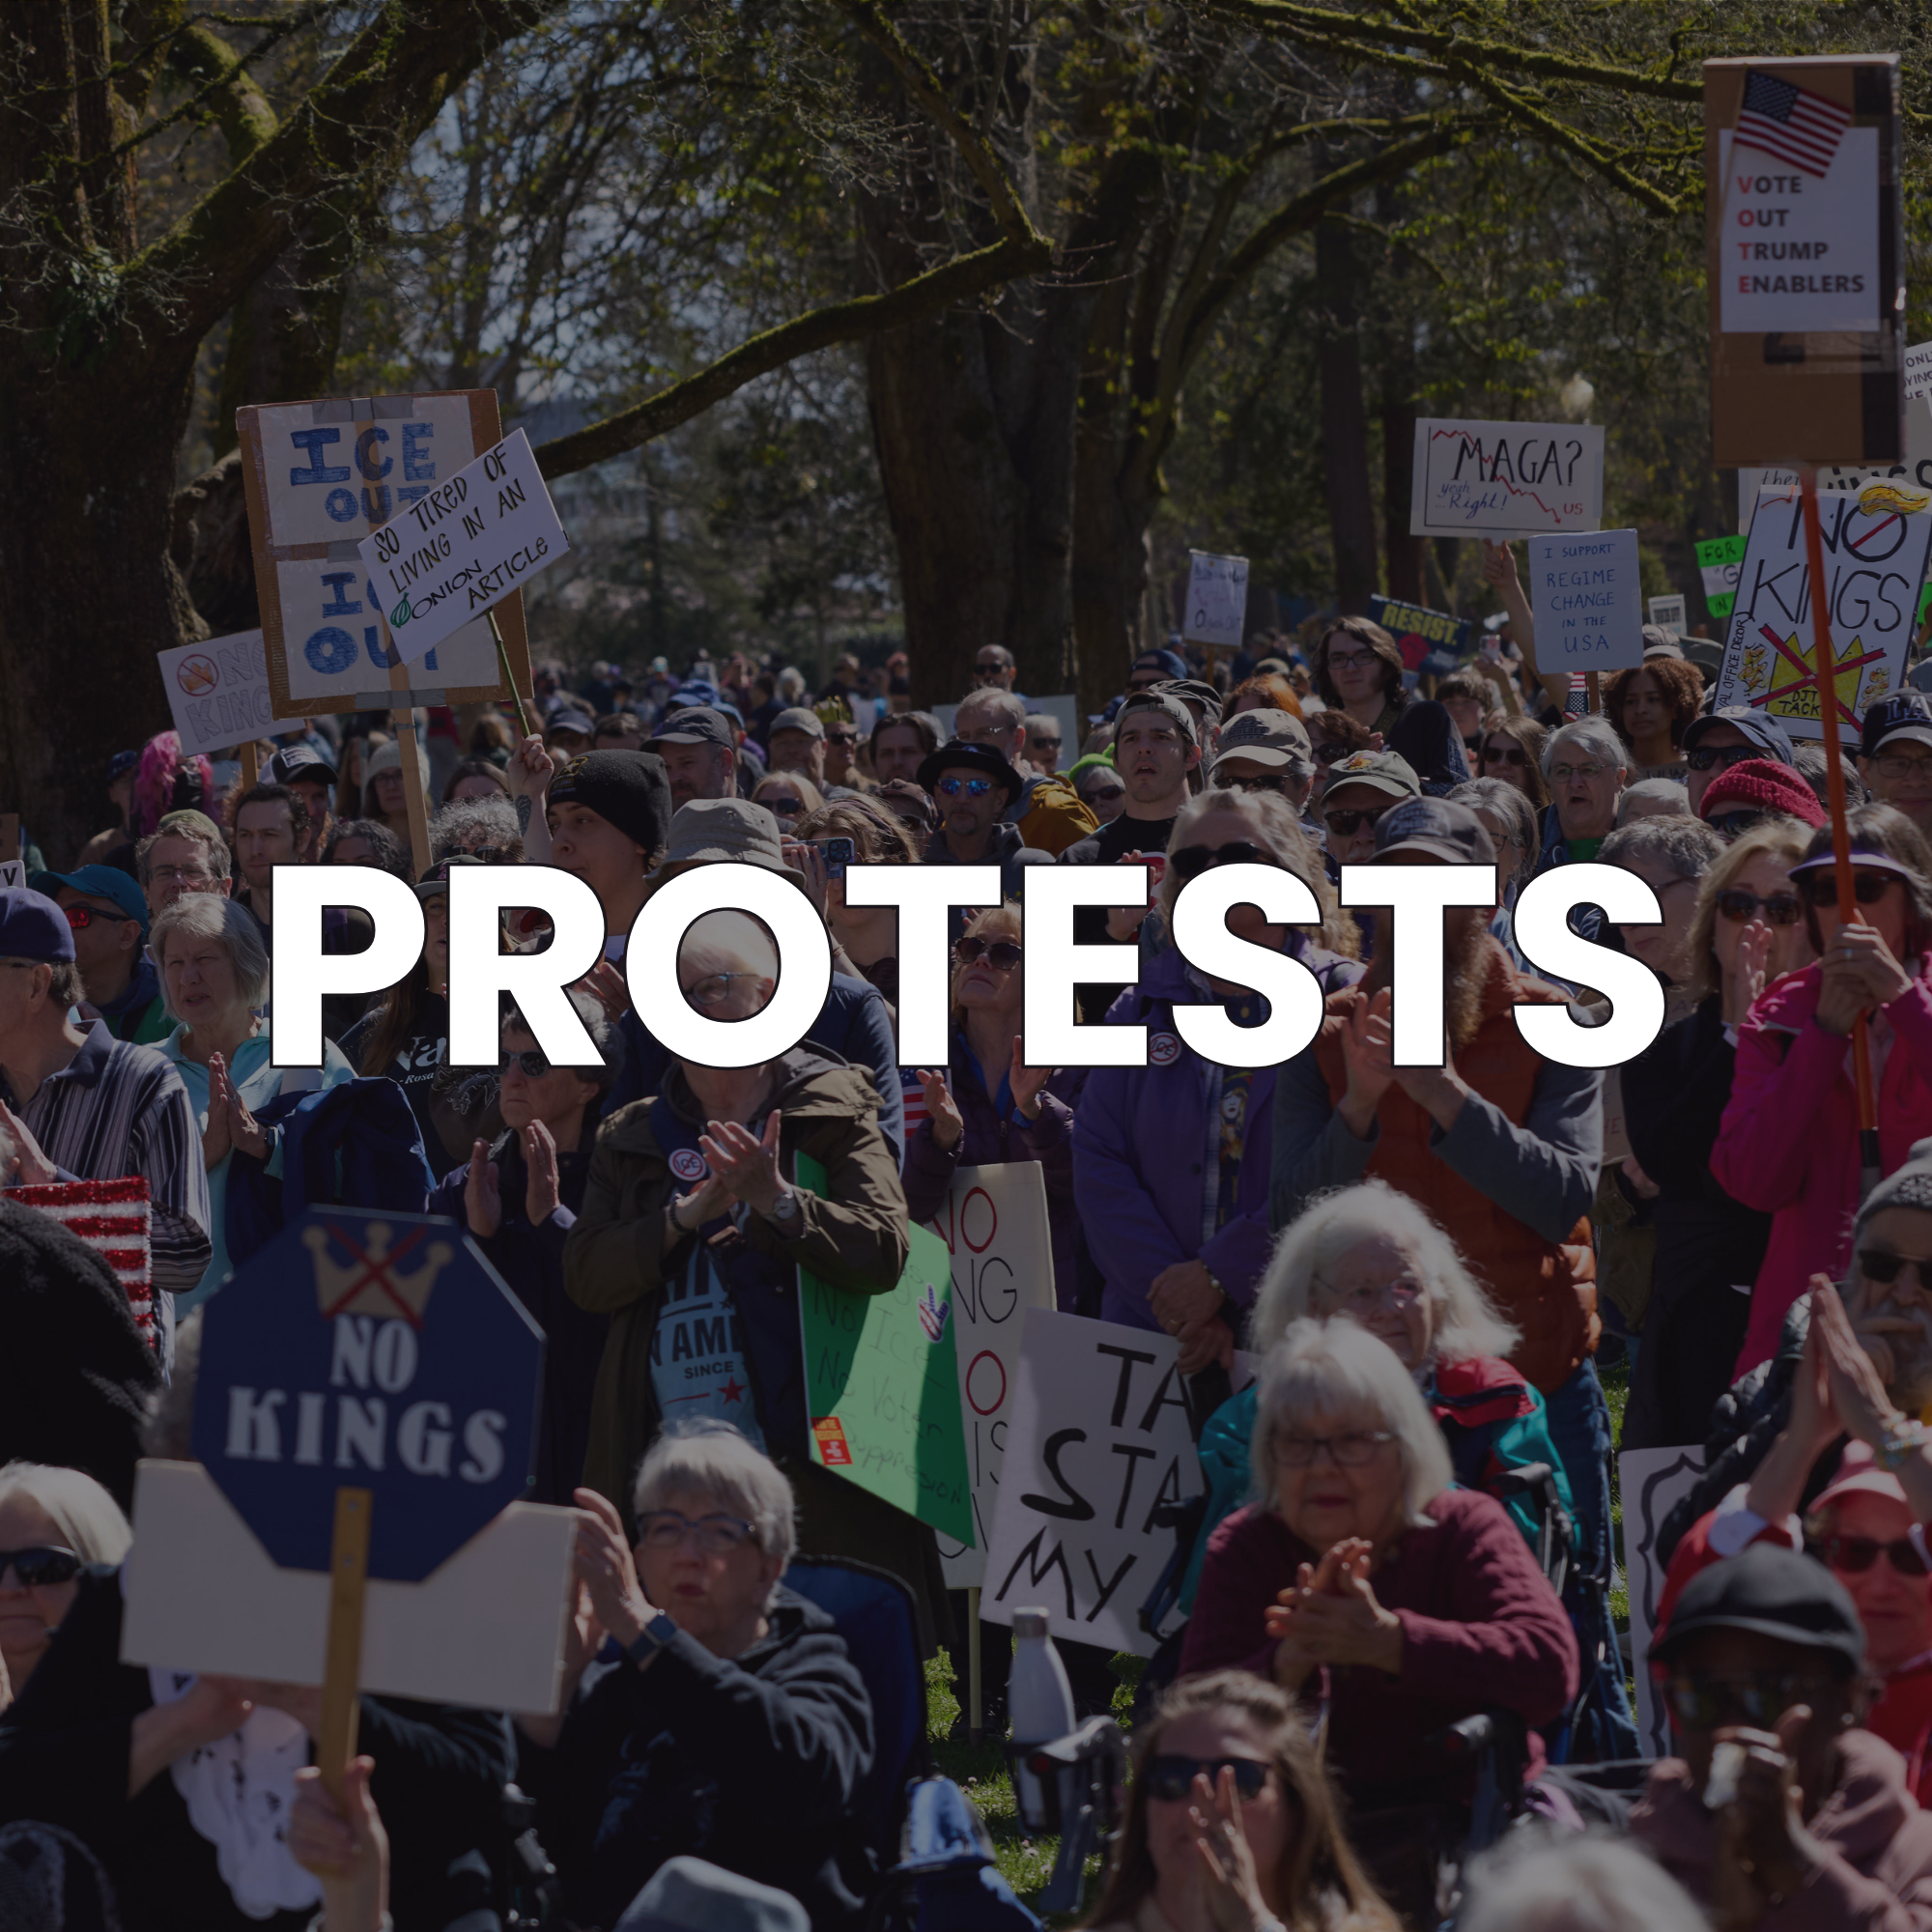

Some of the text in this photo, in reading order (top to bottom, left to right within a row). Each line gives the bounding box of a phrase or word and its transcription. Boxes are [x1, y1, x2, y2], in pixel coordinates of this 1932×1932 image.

[1737, 176, 1802, 194] VOTE
[1738, 209, 1789, 227] OUT
[1738, 242, 1829, 261] TRUMP
[1739, 274, 1864, 294] ENABLERS
[291, 423, 436, 486] ICE
[1451, 437, 1583, 486] MAGA?
[375, 526, 400, 563] SO
[483, 443, 507, 481] OF
[1564, 503, 1583, 515] US
[388, 478, 526, 594] LIVING IN AN
[1545, 543, 1615, 558] I SUPPORT
[1704, 541, 1736, 560] FOR
[1547, 568, 1616, 587] REGIME
[412, 559, 482, 619] ONION
[1551, 591, 1615, 611] CHANGE
[1380, 603, 1460, 646] RESIST.
[1562, 615, 1607, 628] IN THE
[1565, 634, 1609, 653] USA
[185, 685, 272, 744] KING
[329, 1313, 418, 1394] NO
[684, 1361, 734, 1379] SINCE
[223, 1384, 508, 1485] KINGS
